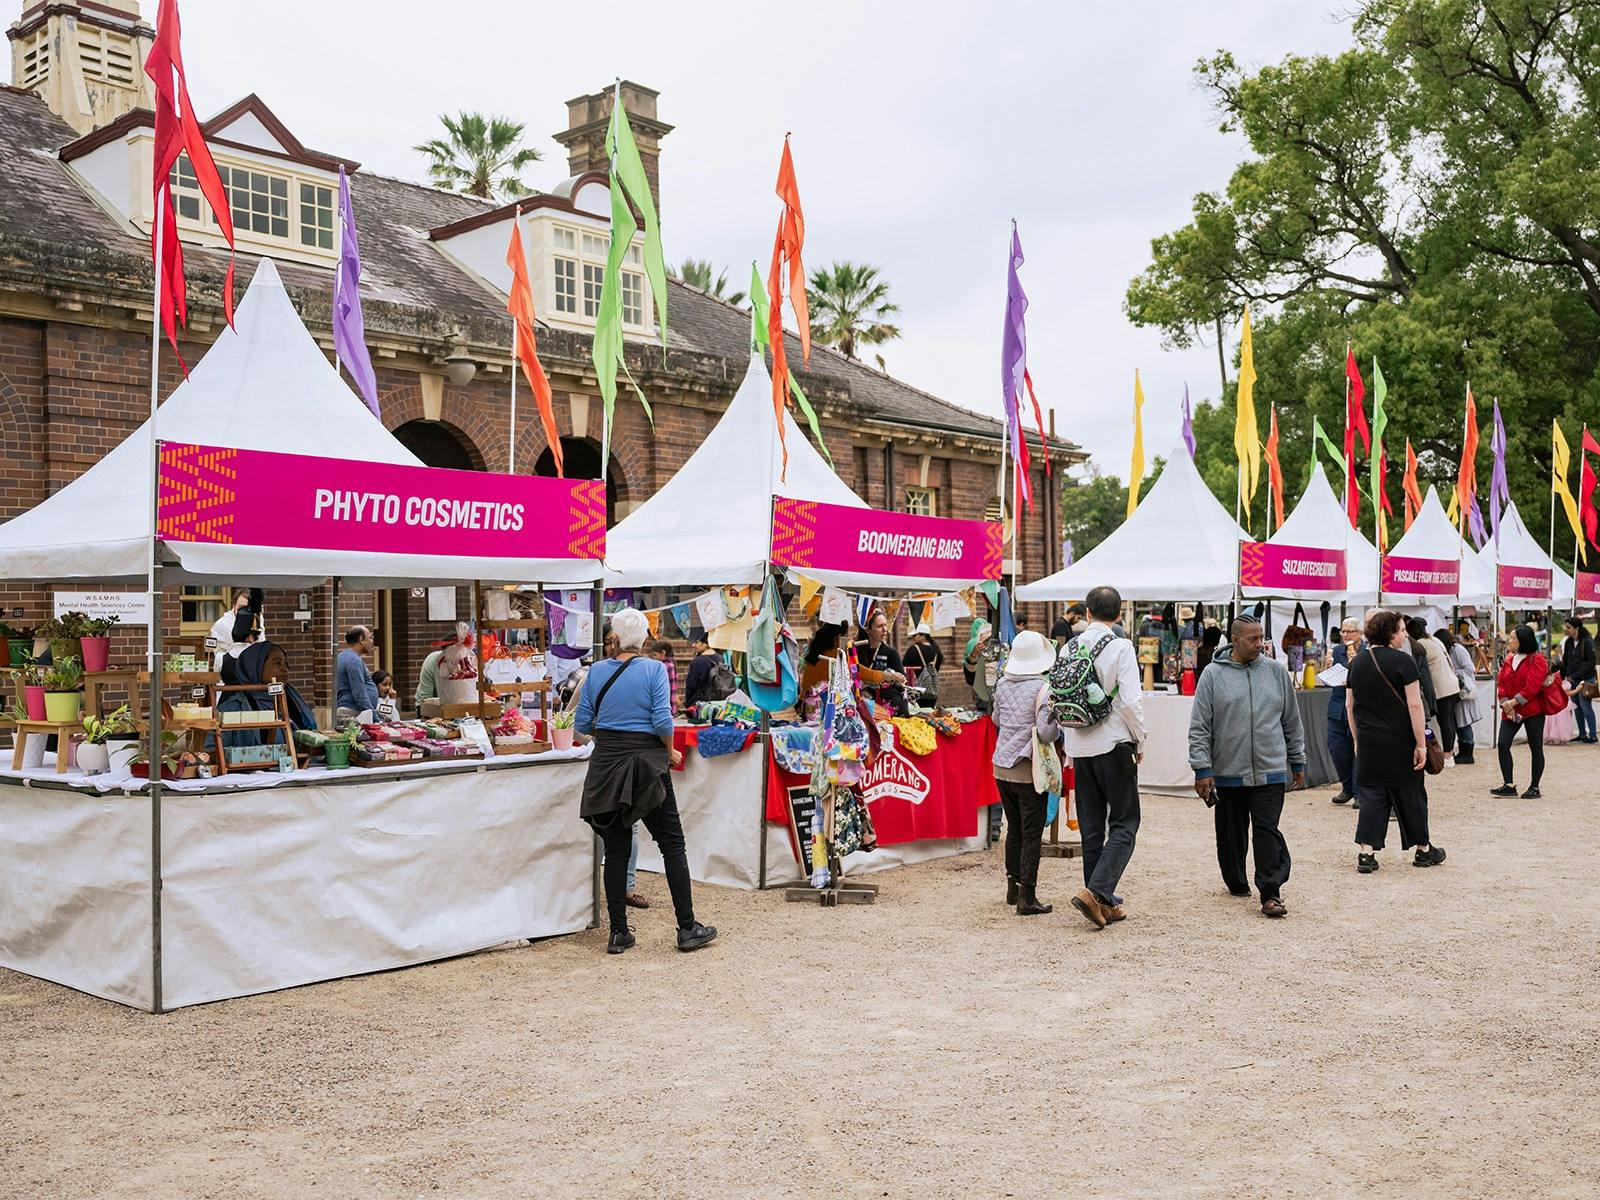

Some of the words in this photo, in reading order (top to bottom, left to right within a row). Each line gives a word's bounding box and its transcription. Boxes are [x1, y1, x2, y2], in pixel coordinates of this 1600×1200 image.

[314, 488, 400, 524] PHYTO
[405, 496, 525, 532] COSMETICS
[858, 529, 937, 559] BOOMERANG
[937, 538, 964, 560] BAGS
[1393, 569, 1418, 583] PASCALE
[1419, 570, 1432, 584] FROM
[860, 754, 920, 789] OMERANG
[873, 785, 899, 795] BAGS
